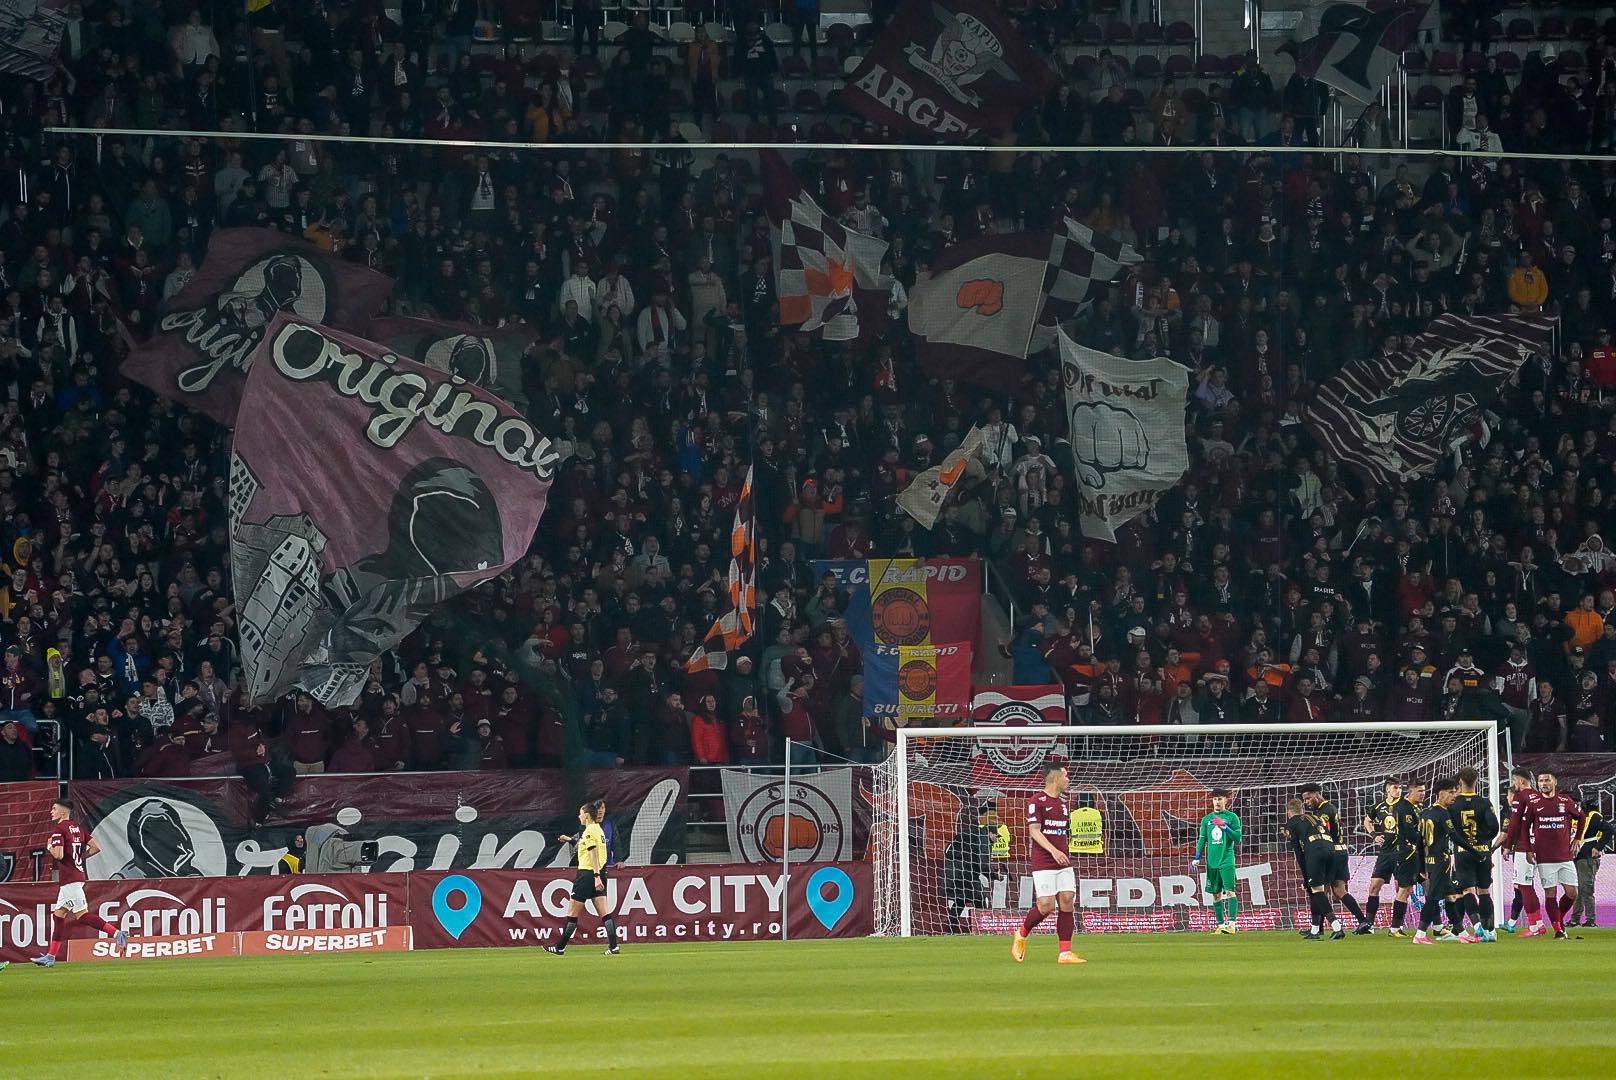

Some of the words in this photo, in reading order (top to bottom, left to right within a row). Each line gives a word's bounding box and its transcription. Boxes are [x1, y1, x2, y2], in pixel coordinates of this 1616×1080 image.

[962, 16, 1001, 58] RAPID
[882, 564, 967, 584] RAPID
[1313, 586, 1335, 594] PARIS
[909, 646, 958, 657] RAPID
[874, 703, 958, 714] BUCURESTI
[740, 823, 754, 835] 19
[822, 822, 840, 834] 98
[1460, 809, 1478, 842] 5
[672, 874, 791, 915] CITY
[263, 893, 388, 932] Ferroli
[264, 929, 388, 952] SUPERBET
